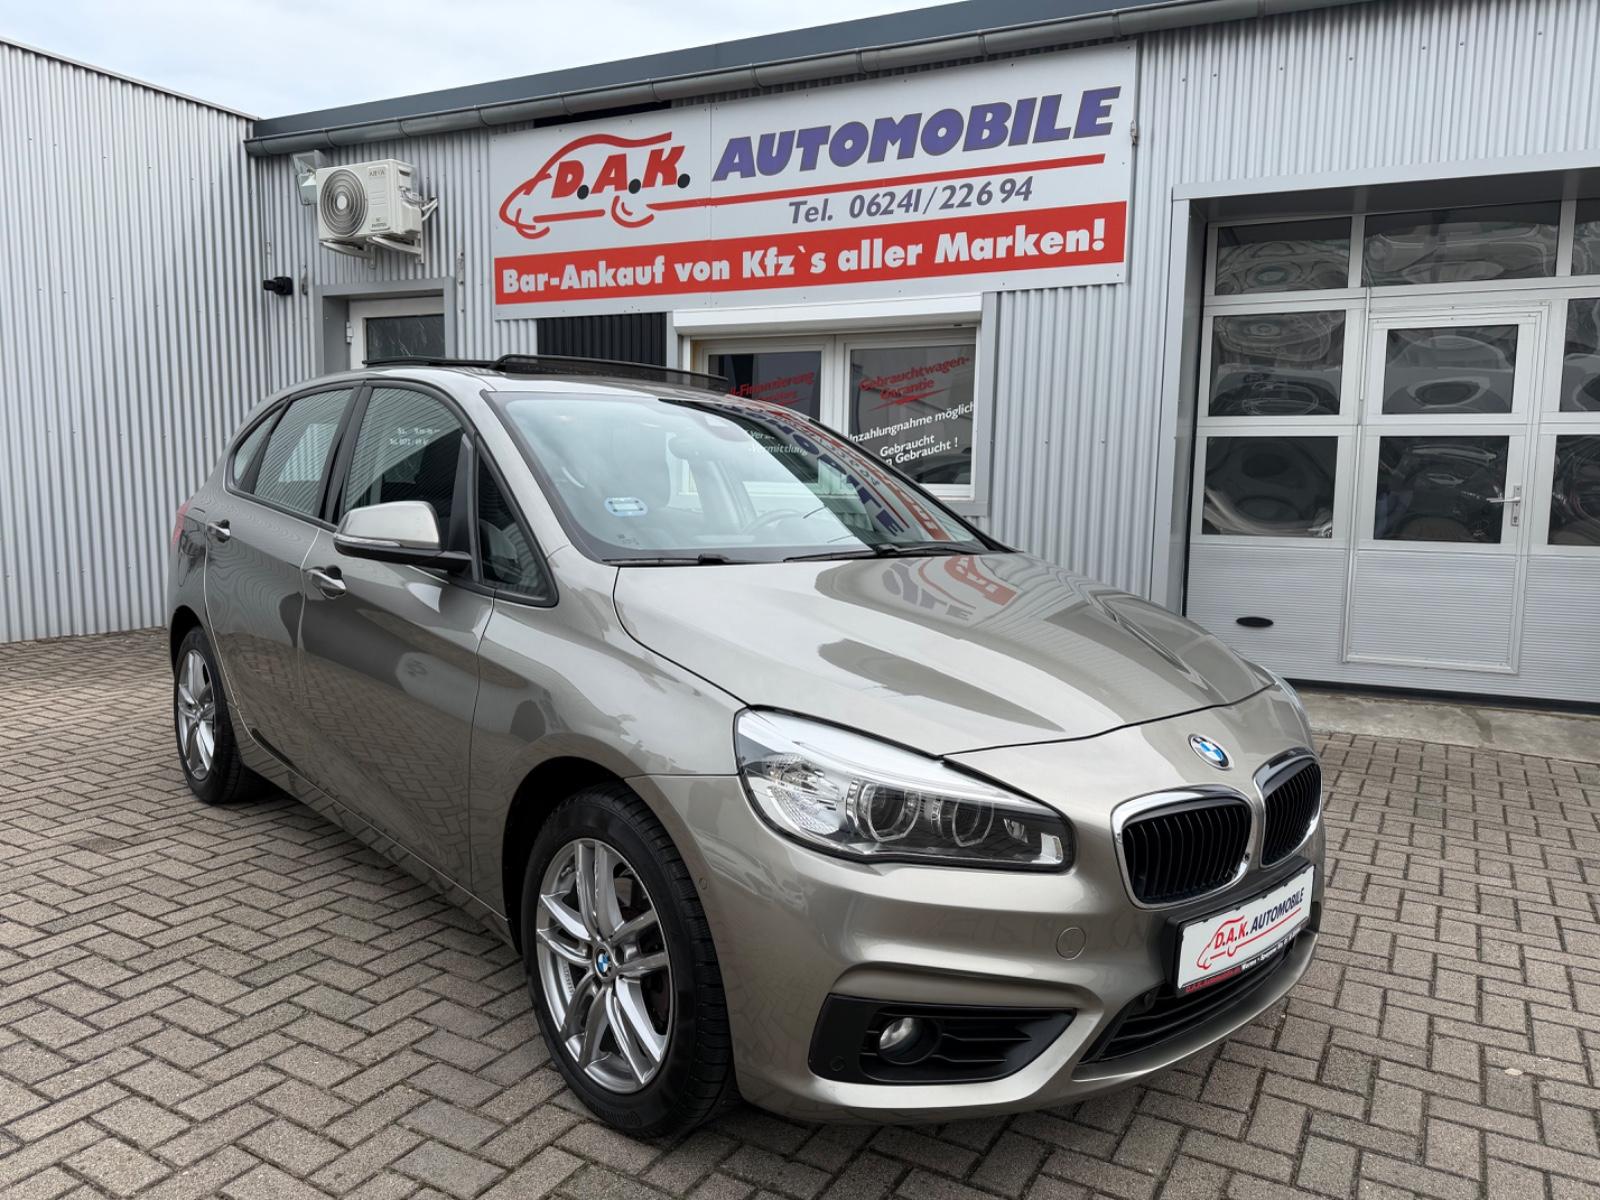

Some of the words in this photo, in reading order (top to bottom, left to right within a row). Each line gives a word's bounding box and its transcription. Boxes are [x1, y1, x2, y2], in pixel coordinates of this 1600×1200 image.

[551, 145, 690, 200] D.A.K.
[712, 86, 1121, 182] AUTOMOBILE
[788, 198, 833, 225] Tel.
[503, 255, 665, 294] Bar-Ankauf
[674, 259, 731, 282] von
[837, 238, 923, 272] aller
[934, 217, 1106, 264] Marken!
[880, 434, 935, 458] Gebraucht
[895, 440, 951, 464] Gebraucht
[1214, 921, 1248, 949] D.A.K.
[1250, 887, 1304, 934] AUTOMOBILE
